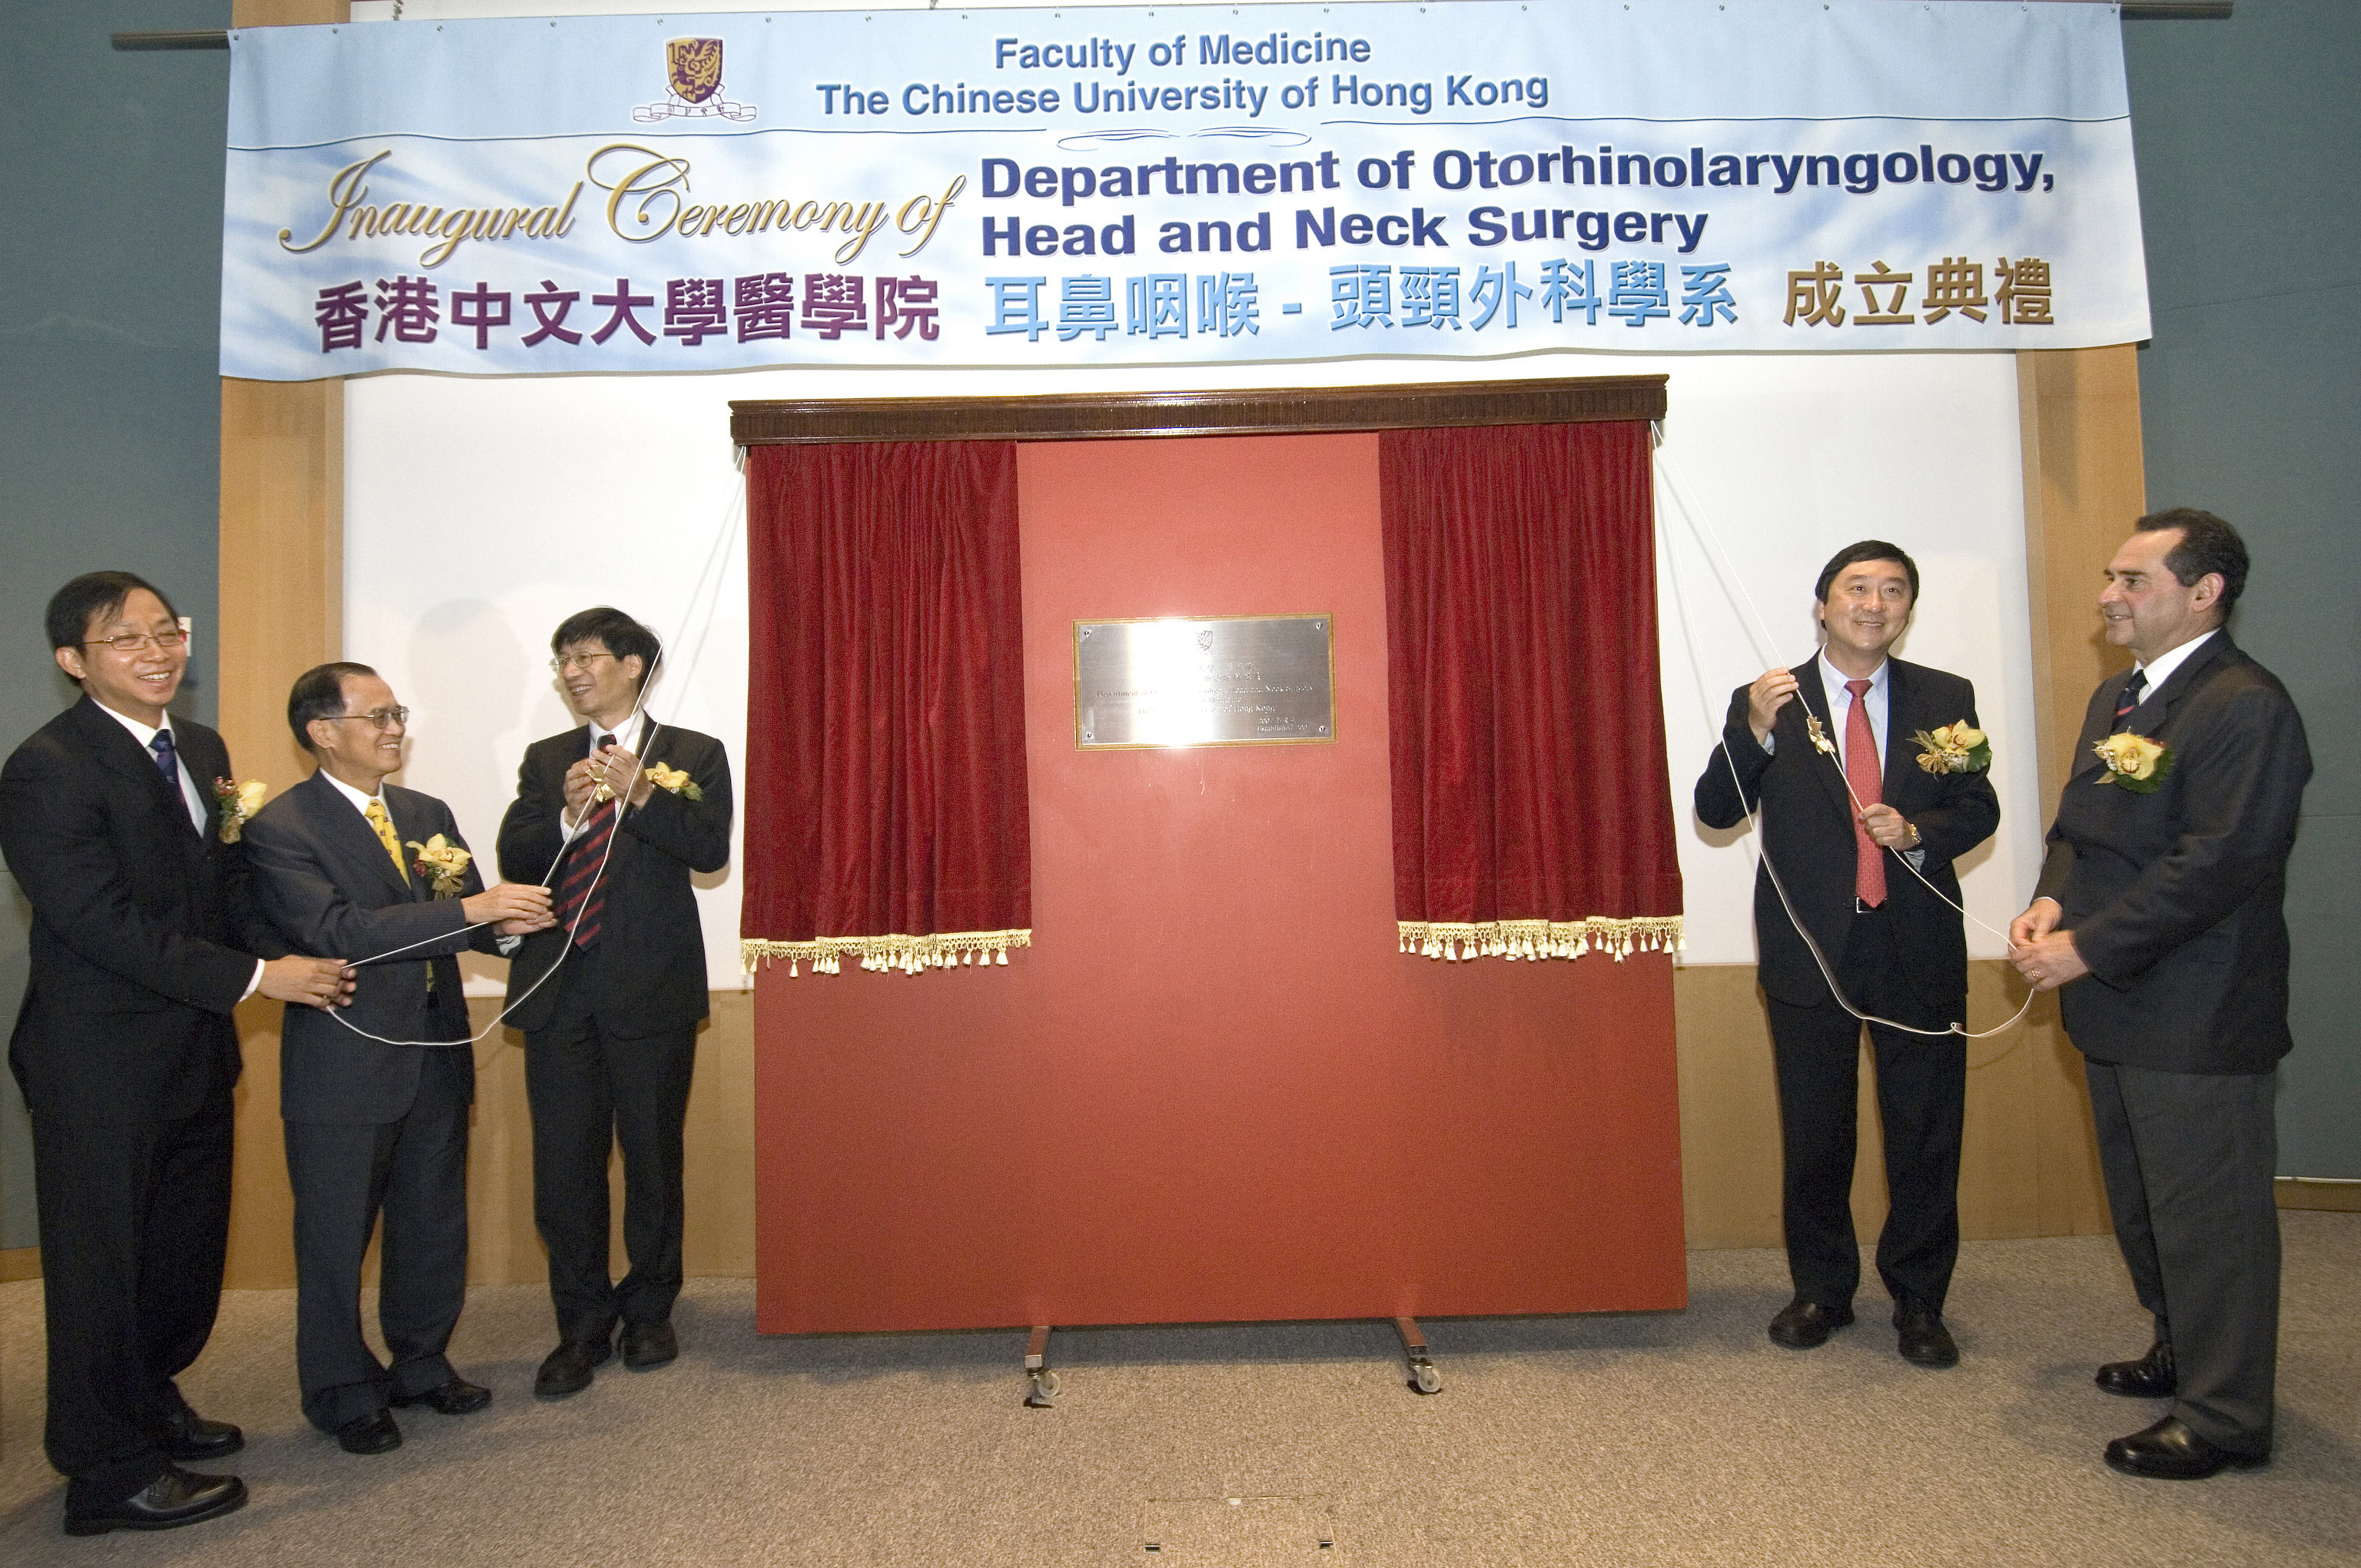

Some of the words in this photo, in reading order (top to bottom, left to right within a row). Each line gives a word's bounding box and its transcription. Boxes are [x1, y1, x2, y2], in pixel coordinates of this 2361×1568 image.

[996, 37, 1136, 75] Faculty
[1149, 34, 1186, 66] of
[1199, 32, 1371, 65] Medicine
[815, 84, 889, 115] The
[903, 83, 1060, 115] Chinese
[1075, 78, 1268, 118] University
[1282, 76, 1319, 109] of
[1333, 75, 1433, 115] Hong
[1447, 74, 1549, 115] Kong
[982, 151, 1340, 200] Department
[1357, 150, 1416, 190] of
[1433, 145, 2054, 195] Otorhinolaryngology,
[279, 149, 584, 268] Inaugural
[587, 144, 888, 266] Ceremony
[896, 174, 967, 257] of
[982, 214, 1136, 256] Head
[1158, 211, 1272, 253] and
[1296, 206, 1450, 249] Neck
[1467, 206, 1708, 254] Surgery
[315, 272, 940, 354] 香港中文大學醫學院
[984, 271, 1260, 343] 耳鼻咽喉
[1282, 303, 1302, 314] -
[1329, 258, 1738, 332] 頭頸外科學系
[1782, 256, 2054, 328] 成立典禮
